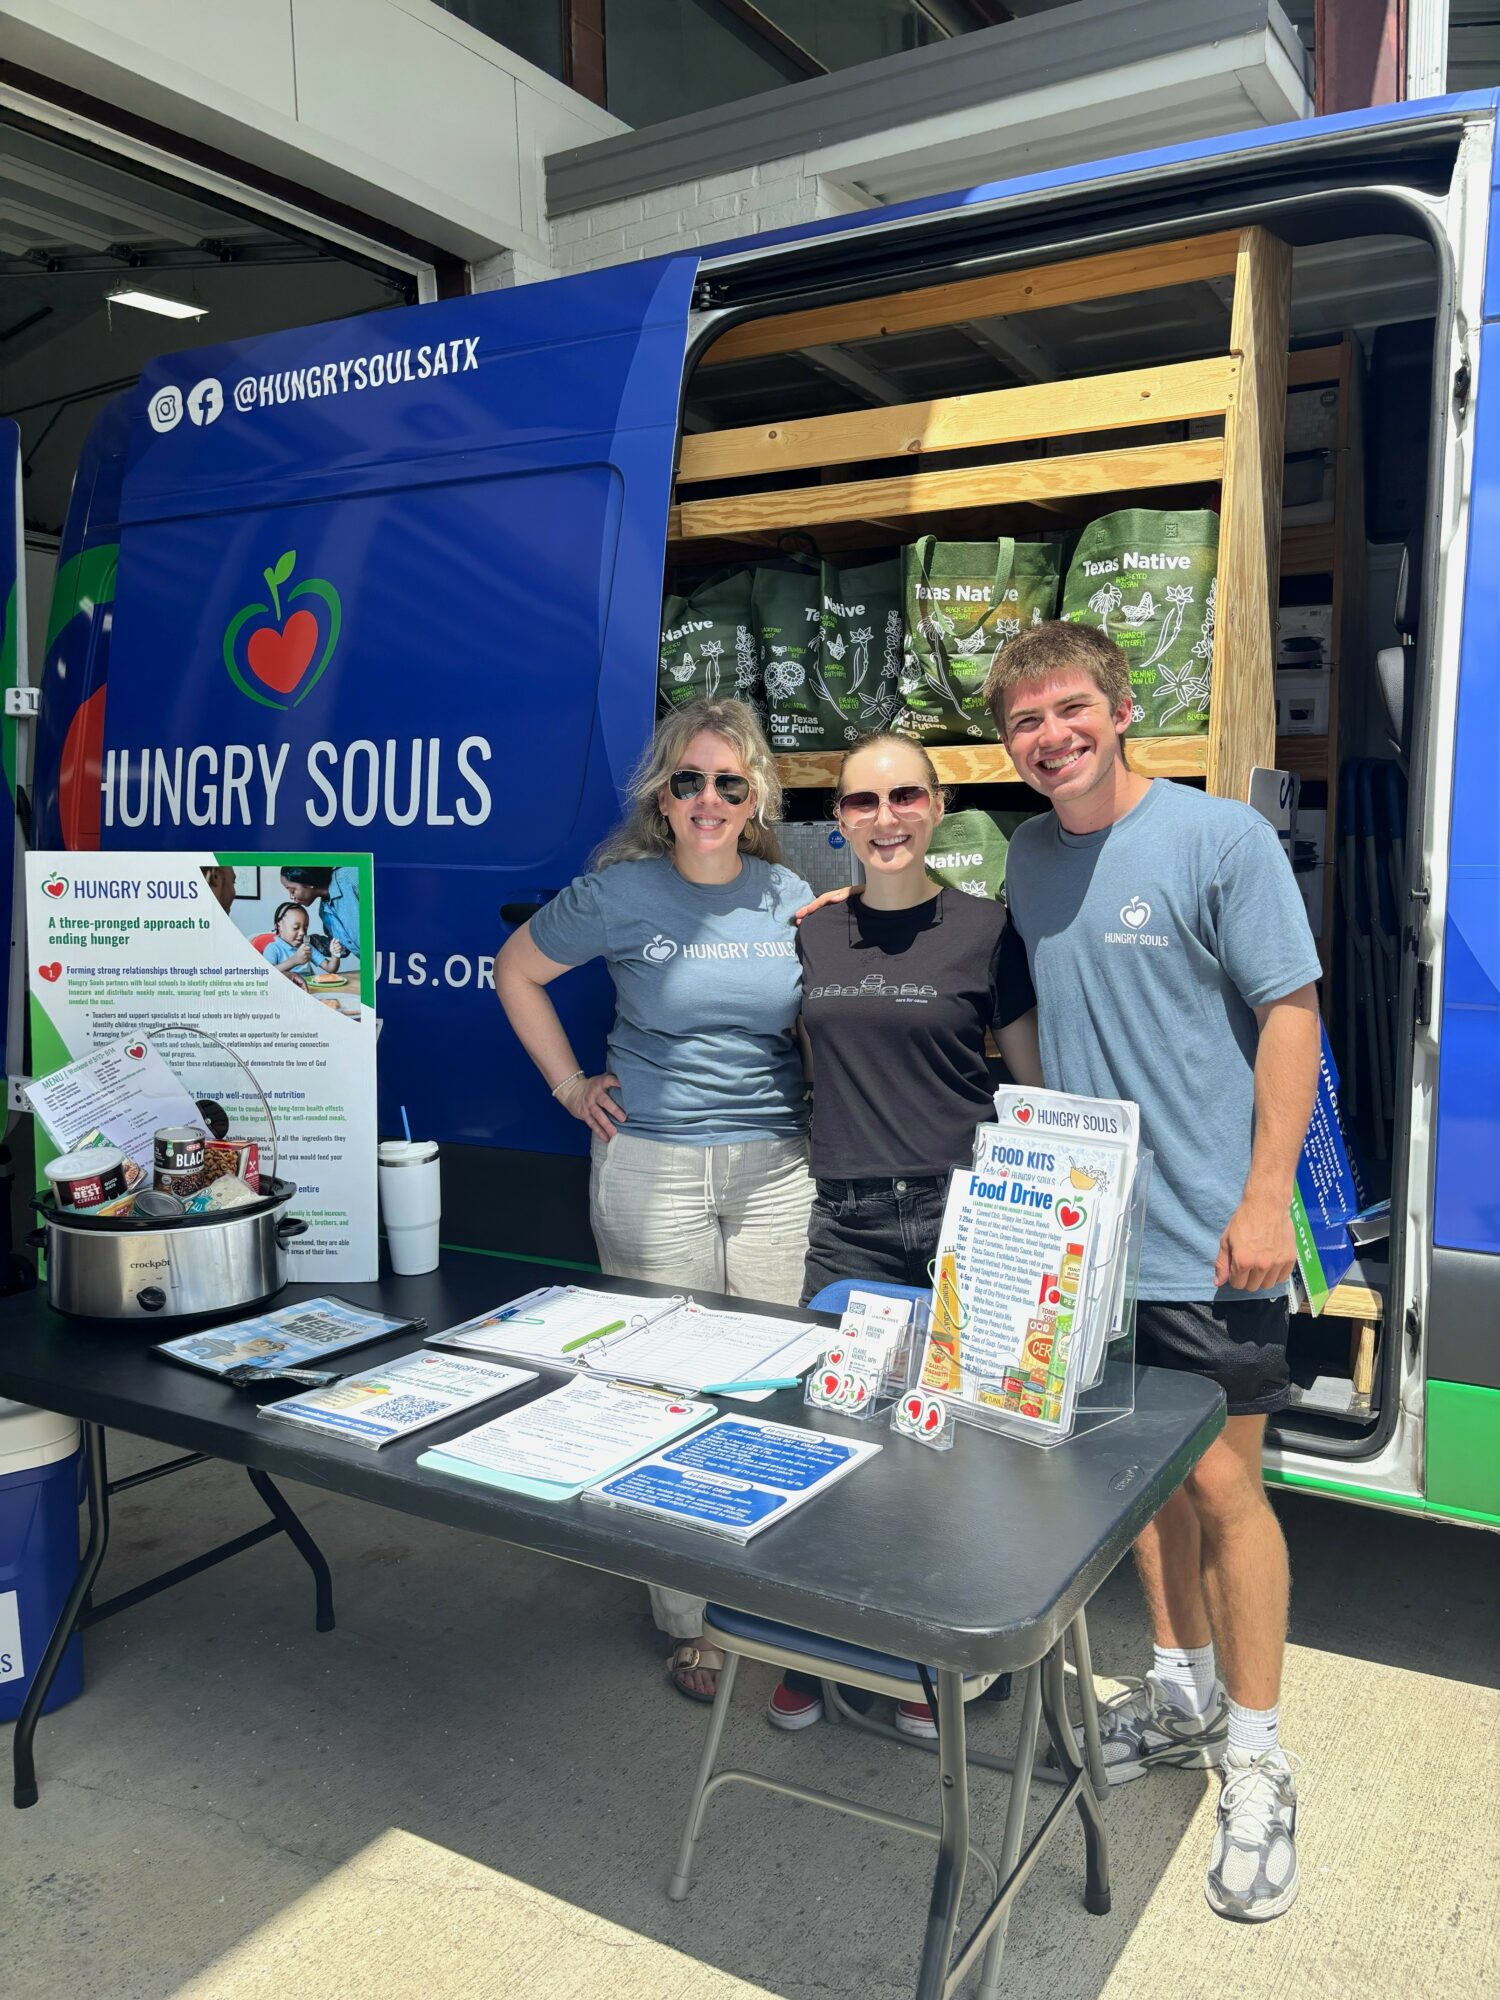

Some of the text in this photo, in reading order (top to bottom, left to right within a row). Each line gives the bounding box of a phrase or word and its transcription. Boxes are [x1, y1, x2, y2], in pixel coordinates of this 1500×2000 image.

[233, 336, 480, 412] @HUNGRYSOULSATX
[1082, 552, 1191, 577] Texas Native
[956, 585, 1018, 601] Natve
[824, 595, 866, 618] Native
[1116, 631, 1146, 640] MONARCH
[1129, 669, 1157, 679] EVENING
[770, 714, 818, 725] Our Texas
[912, 711, 939, 723] Texas
[771, 724, 824, 735] Our Future
[101, 736, 491, 827] HUNGRY SOULS
[924, 852, 983, 870] Native
[74, 880, 198, 899] HUNGRY SOULS
[49, 917, 210, 931] A three-pronged approach to
[49, 933, 130, 947] ending hunger
[1105, 932, 1169, 946] HUNGRY SOULS
[683, 942, 795, 959] HUNGRY SOULS
[67, 966, 269, 976] Forming strong relationships through school partnerships
[68, 979, 88, 987] Hungry
[106, 979, 128, 988] partners
[187, 979, 208, 988] identify
[256, 979, 268, 987] food
[92, 1011, 116, 1019] Teachers
[118, 1011, 127, 1019] and
[129, 1012, 149, 1020] support
[151, 1011, 179, 1020] specialists
[234, 1012, 250, 1020] highly
[92, 1021, 113, 1029] identify
[139, 1021, 166, 1029] struggling
[92, 1031, 119, 1039] Arranging
[166, 1032, 188, 1040] through
[248, 1031, 279, 1040] opportunity
[227, 1041, 262, 1049] relationships
[274, 1041, 298, 1049] ensuring
[172, 1052, 196, 1060] progress.
[202, 1060, 236, 1069] relationships
[42, 1073, 64, 1090] MENU
[197, 1091, 223, 1101] through
[274, 1091, 305, 1099] nutrition
[1038, 1109, 1118, 1134] HUNGRY SOULS
[1316, 1090, 1343, 1178] Austin-based
[1320, 1052, 1366, 1208] UNGRY SOUL
[991, 1145, 1056, 1172] FOOD KITS
[1315, 1135, 1333, 1188] provide
[1316, 1119, 1347, 1213] partners with
[1310, 1138, 1330, 1201] for food-
[1011, 1171, 1036, 1182] HUNGRY
[1037, 1176, 1056, 1186] SOULS
[73, 1187, 101, 1200] BEST
[298, 1185, 320, 1193] entire
[969, 1174, 1006, 1202] Food
[1012, 1179, 1053, 1210] Drive
[1309, 1161, 1331, 1227] and their
[316, 1240, 327, 1248] they
[130, 1258, 171, 1269] crockpot
[280, 1321, 340, 1343] MENUS
[294, 1314, 363, 1338] WEEKLY
[441, 1360, 509, 1380] HUNGRY SOULS
